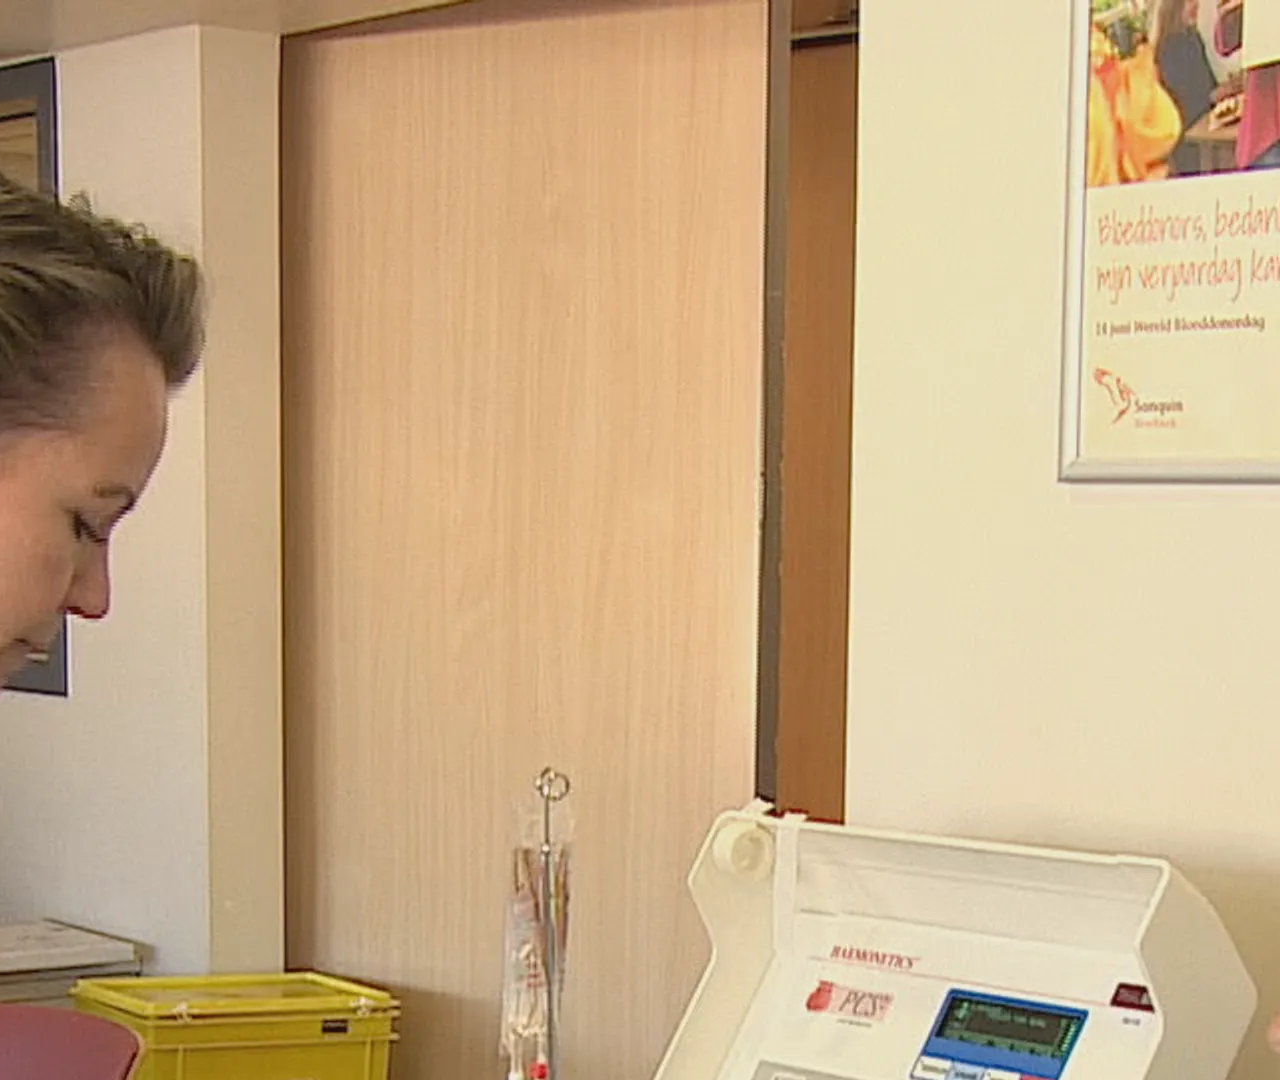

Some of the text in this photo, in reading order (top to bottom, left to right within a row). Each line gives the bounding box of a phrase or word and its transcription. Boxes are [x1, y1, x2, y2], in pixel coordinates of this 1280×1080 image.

[1096, 260, 1132, 305] mijn
[1138, 245, 1242, 303] verjaardag
[1134, 318, 1171, 334] Wereld
